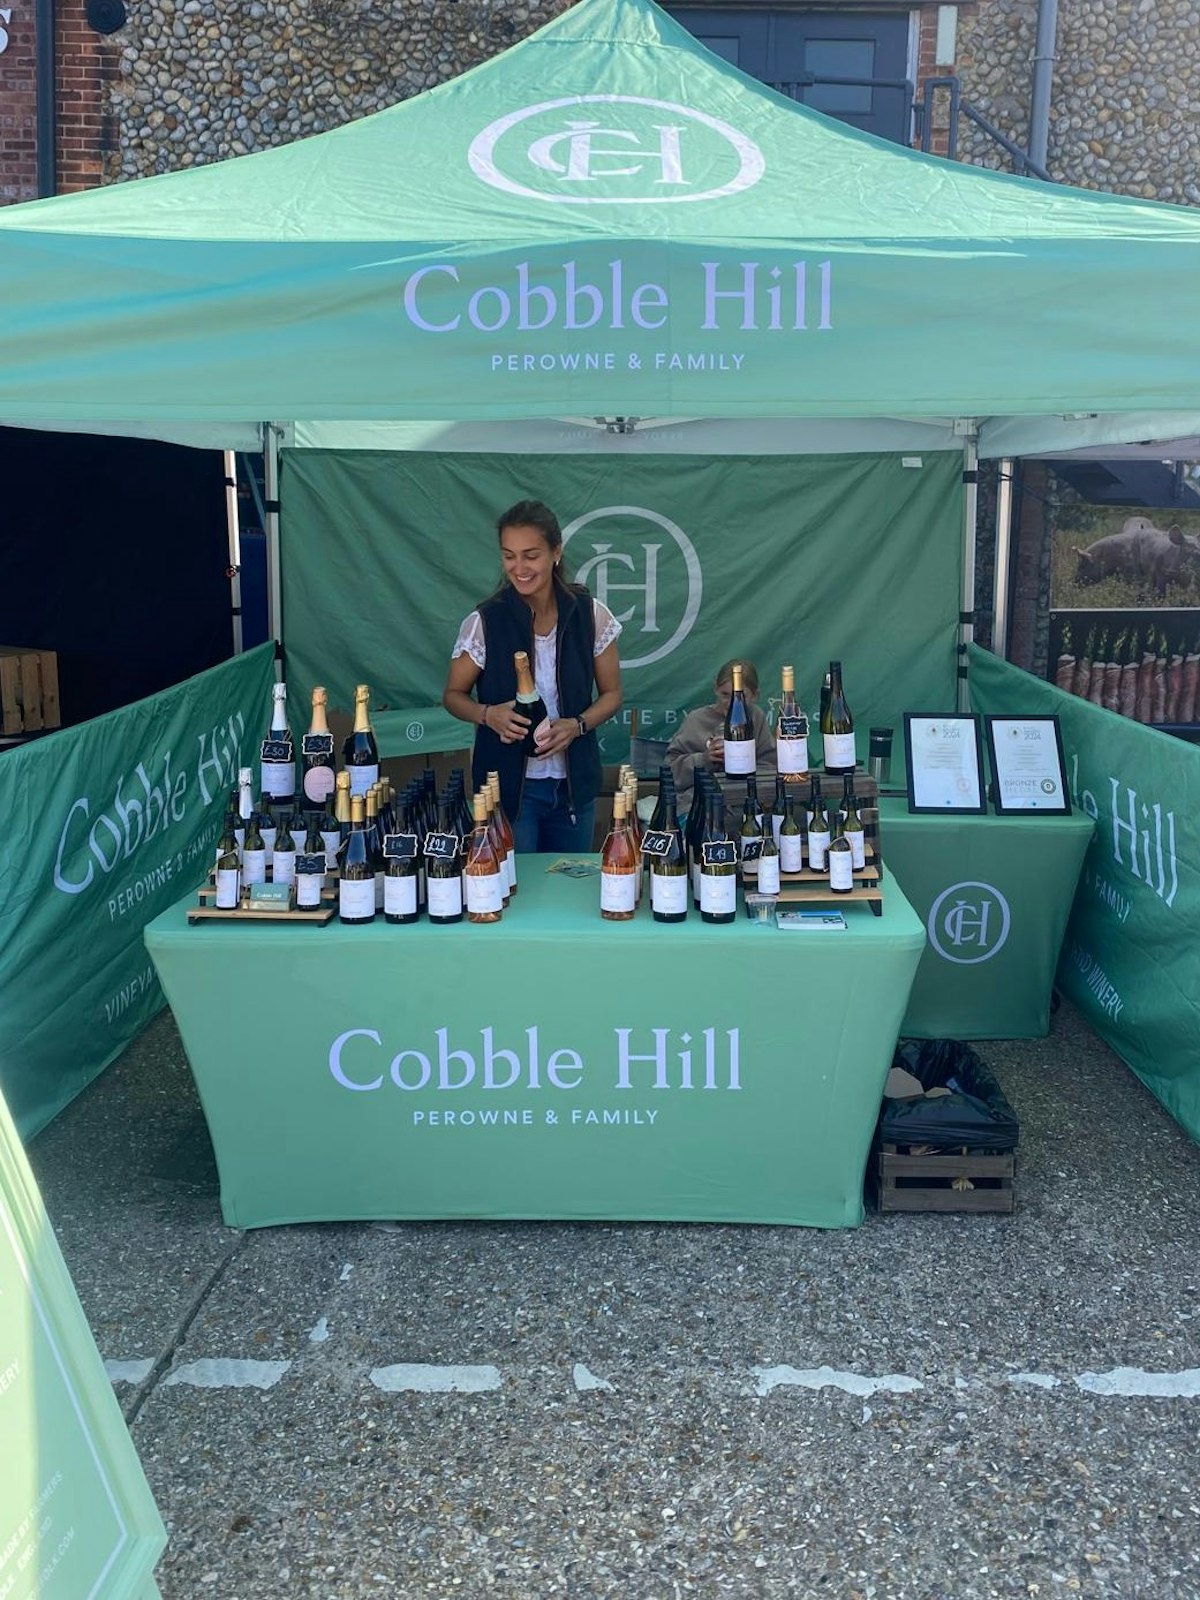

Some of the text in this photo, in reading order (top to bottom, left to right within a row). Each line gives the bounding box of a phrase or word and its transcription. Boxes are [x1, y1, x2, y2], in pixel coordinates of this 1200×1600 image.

[402, 259, 834, 333] Cobble Hill
[491, 353, 745, 371] PEROWNE & FAMILY
[54, 711, 245, 894] Cobble Hill
[108, 859, 173, 921] PEROWNE
[187, 820, 219, 862] FAMILY
[644, 836, 666, 851] £16
[1109, 777, 1178, 908] Hill
[1094, 873, 1131, 924] FAMILY
[105, 966, 157, 1024] VINEYA
[1086, 963, 1124, 1023] WINERY
[329, 1025, 742, 1091] Cobble Hill
[413, 1109, 659, 1126] PEROWNE & FAMILY
